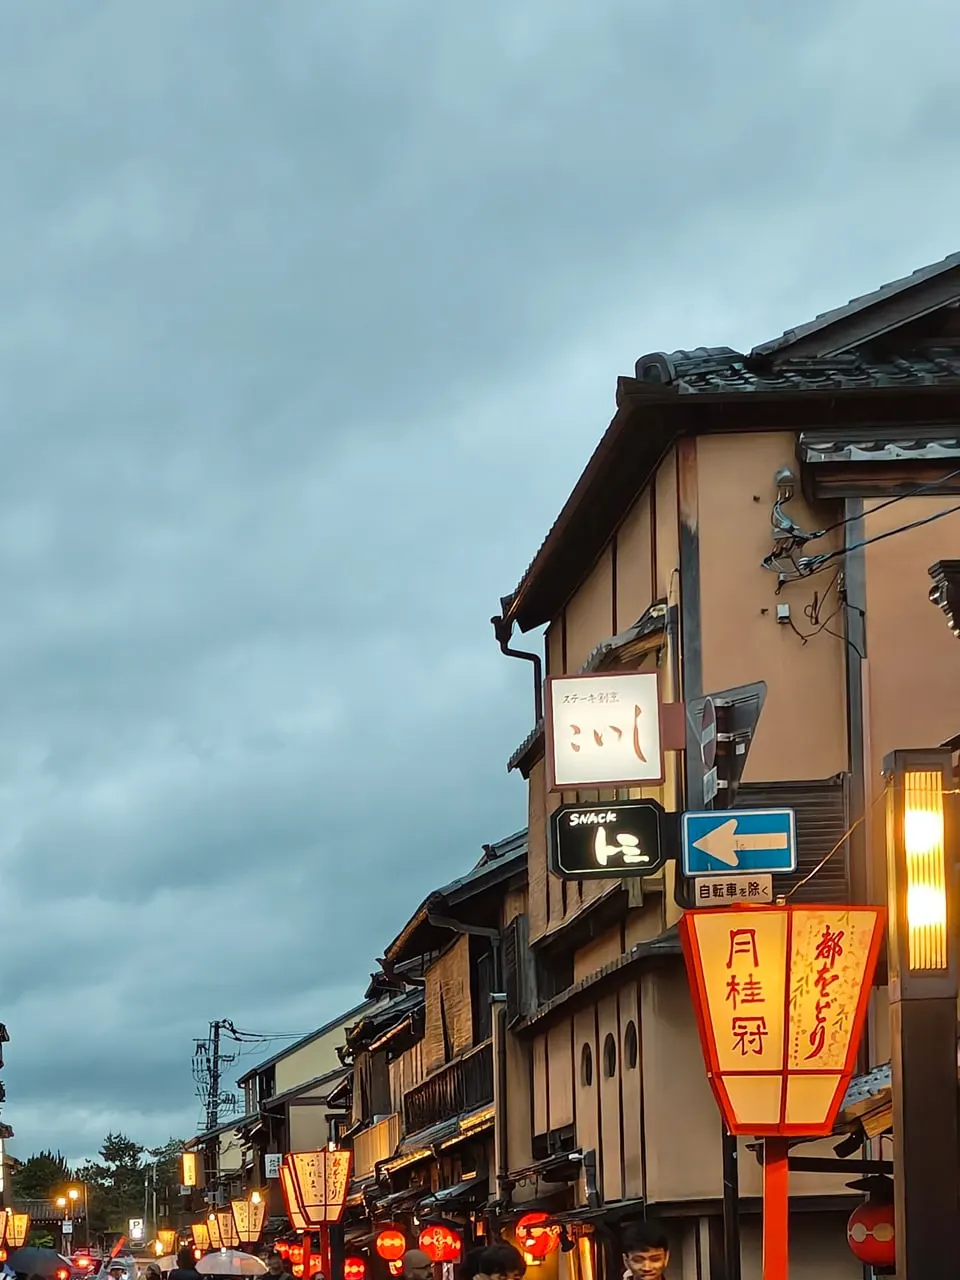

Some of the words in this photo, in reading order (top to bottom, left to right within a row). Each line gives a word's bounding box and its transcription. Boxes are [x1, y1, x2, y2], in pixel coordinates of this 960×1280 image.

[570, 704, 647, 763] こいし
[699, 881, 769, 899] 自転車を除く
[725, 928, 768, 1056] 月桂冠
[803, 924, 845, 1061] 都をどり
